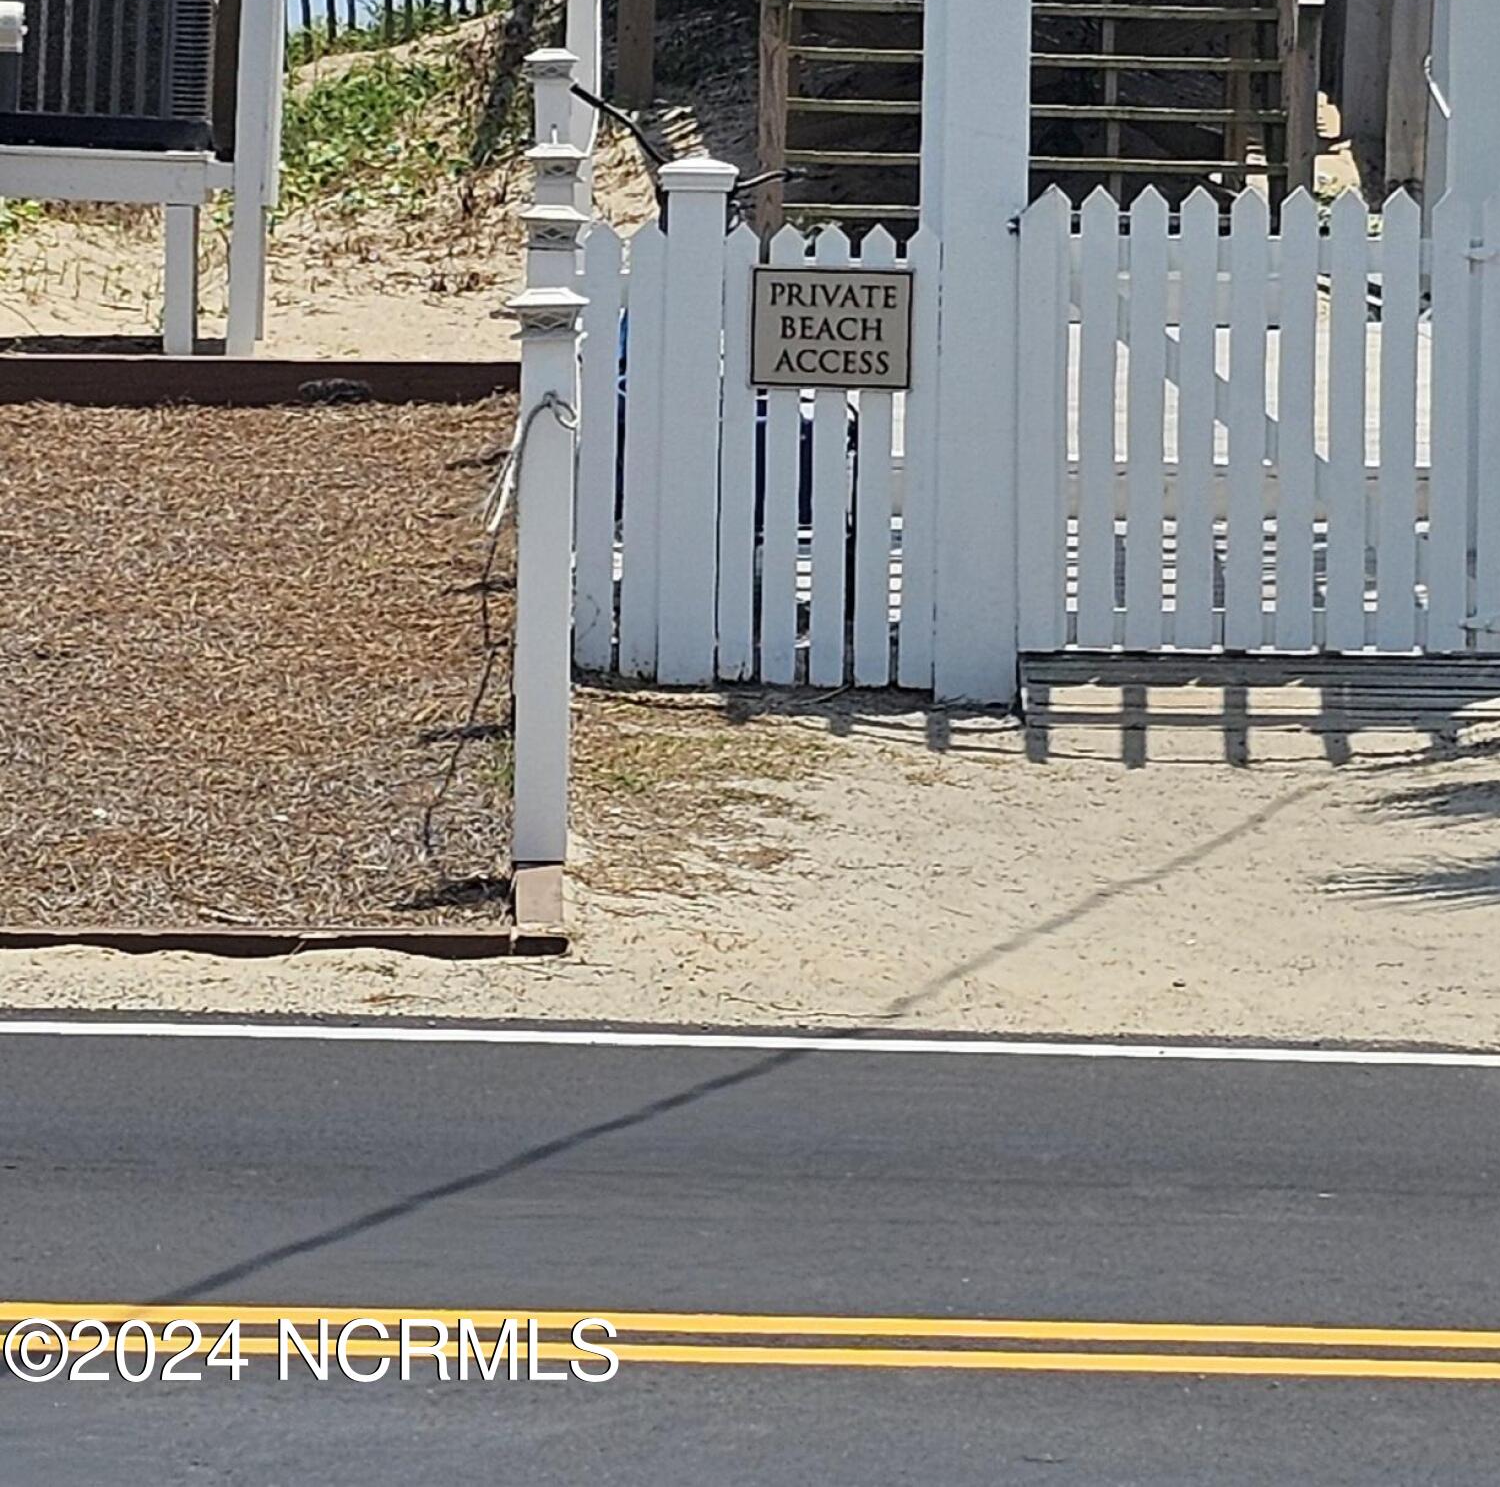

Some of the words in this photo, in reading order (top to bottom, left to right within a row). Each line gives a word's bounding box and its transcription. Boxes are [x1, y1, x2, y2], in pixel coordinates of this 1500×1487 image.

[770, 283, 897, 308] PRIVATE
[781, 316, 882, 341] BEACH
[774, 349, 889, 375] ACCESS
